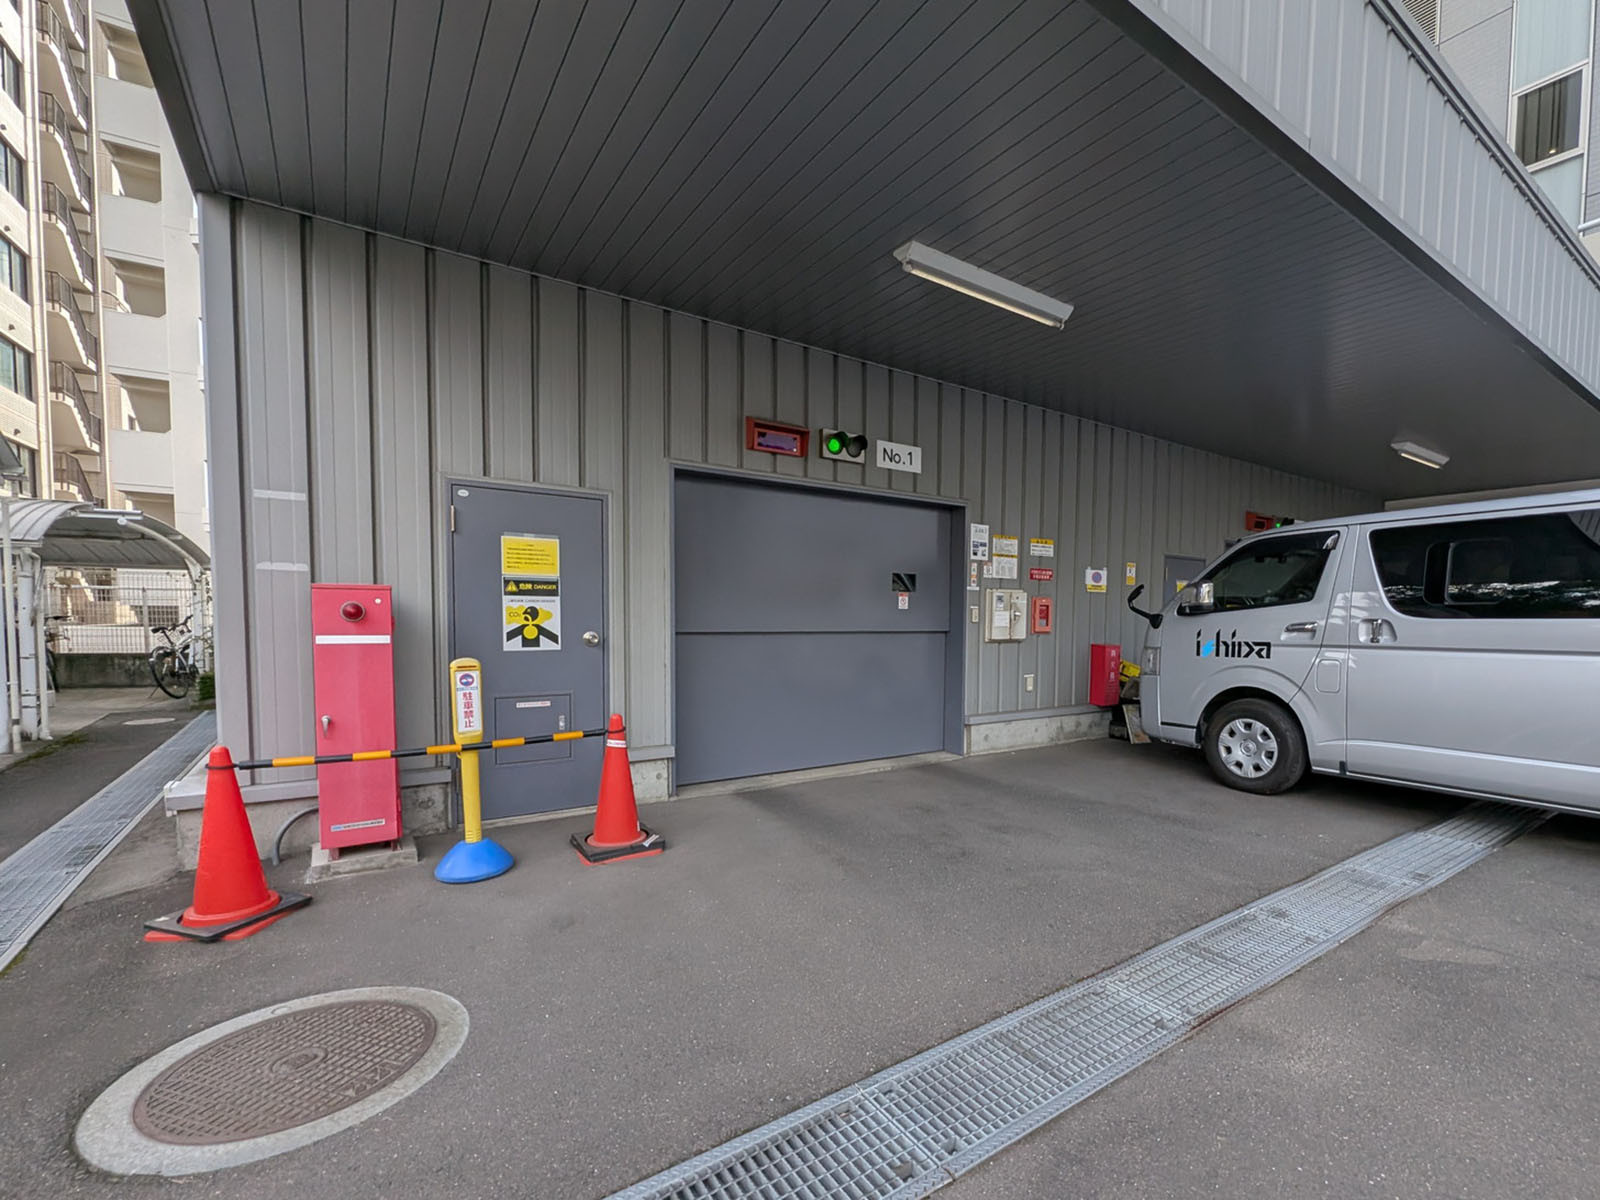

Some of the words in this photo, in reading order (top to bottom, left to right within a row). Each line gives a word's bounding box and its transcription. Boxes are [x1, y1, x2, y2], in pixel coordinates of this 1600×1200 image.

[882, 446, 914, 466] No.1
[462, 691, 475, 729] 駐車禁止
